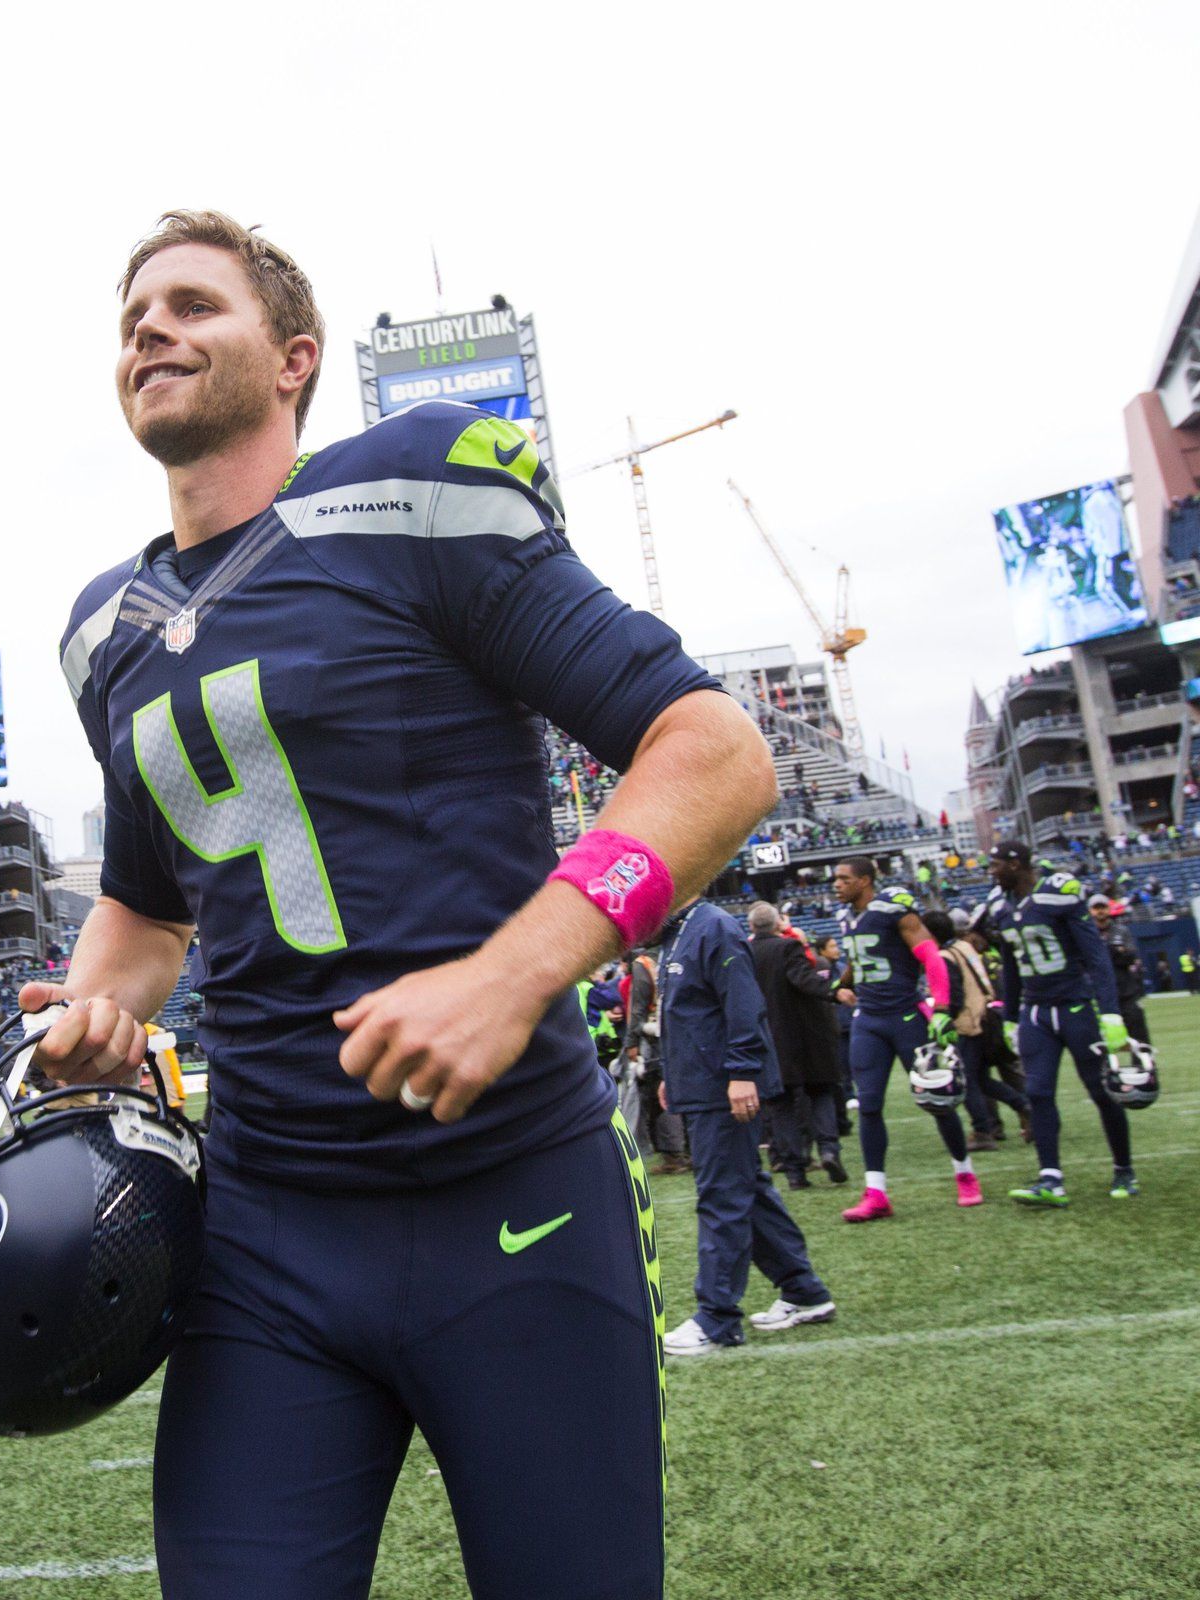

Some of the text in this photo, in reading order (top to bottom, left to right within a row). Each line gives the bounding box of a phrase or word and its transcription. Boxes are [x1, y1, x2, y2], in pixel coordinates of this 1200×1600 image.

[373, 310, 516, 354] CENTURYLINK
[419, 342, 477, 367] FIELD
[389, 367, 514, 403] BUD LIGHT
[316, 500, 414, 517] SEAHAWKS
[133, 658, 348, 955] 4
